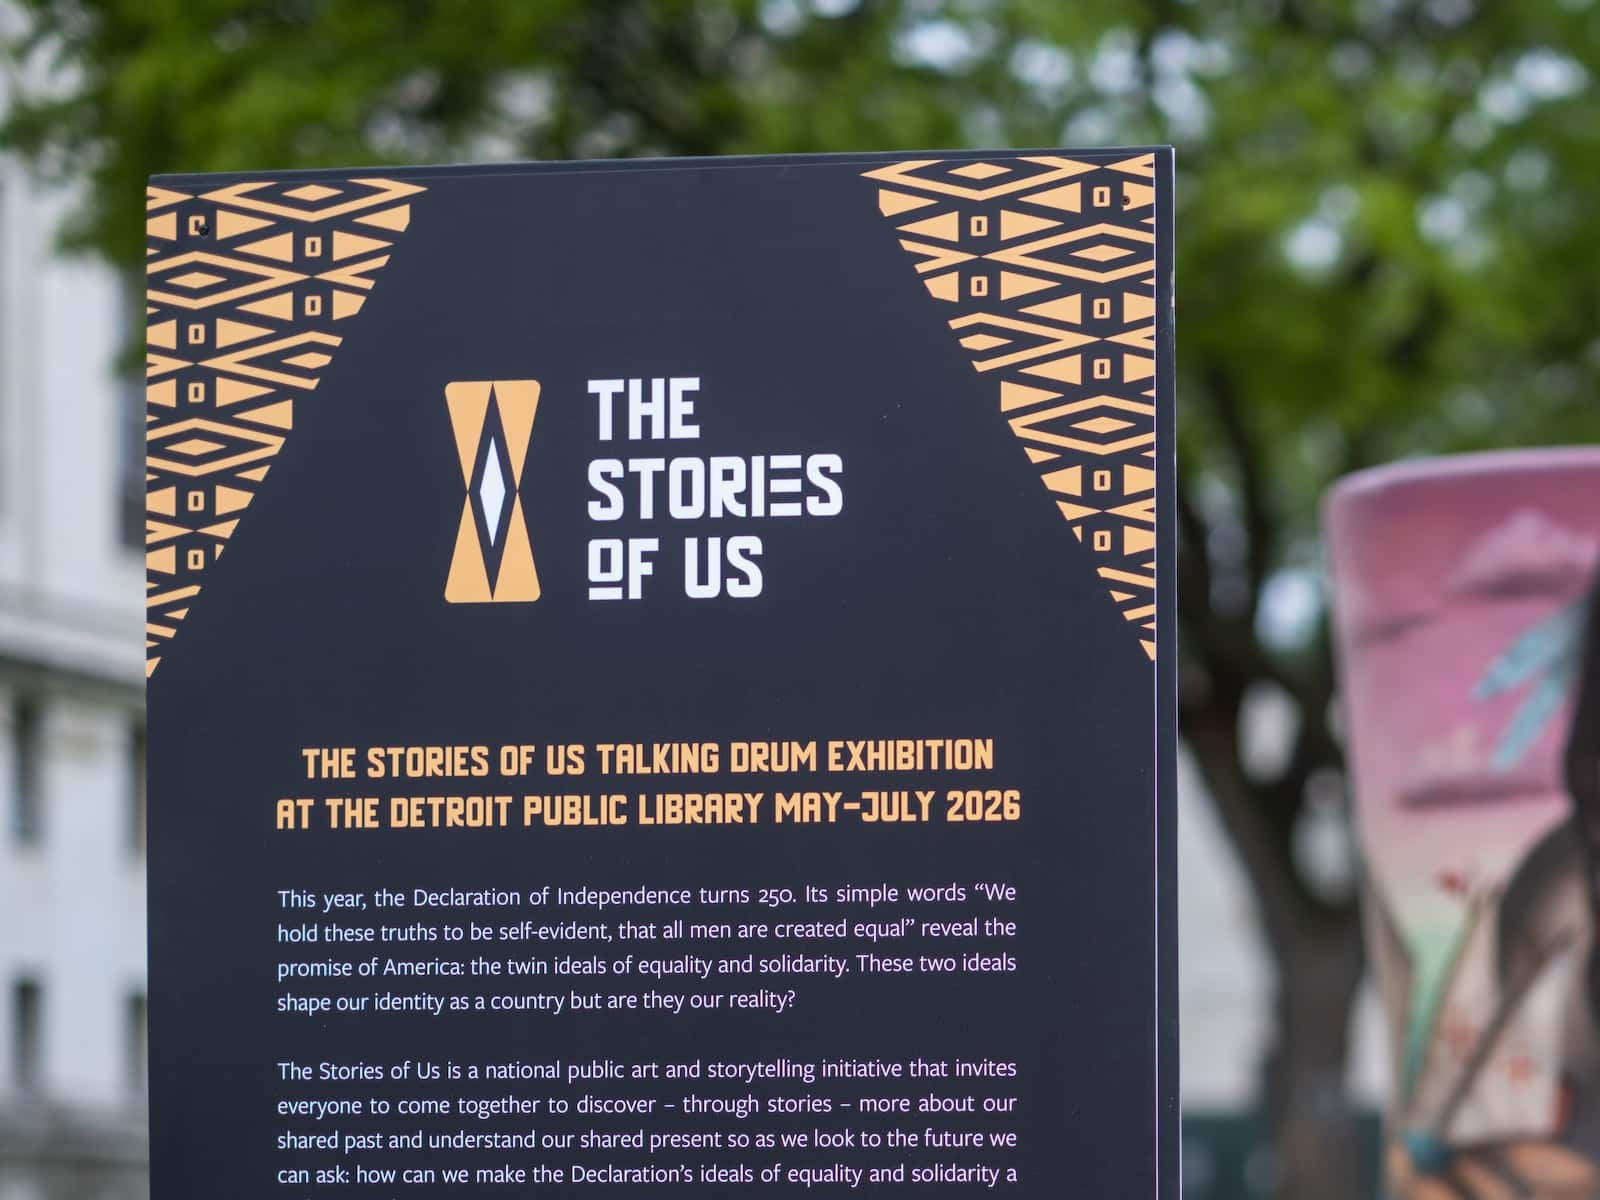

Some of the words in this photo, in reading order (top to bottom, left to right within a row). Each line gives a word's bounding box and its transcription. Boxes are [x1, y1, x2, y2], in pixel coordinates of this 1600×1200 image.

[587, 376, 701, 441] THE
[587, 453, 844, 522] STORIES
[587, 537, 660, 601] OF
[684, 535, 763, 599] US
[302, 747, 356, 779] THE
[367, 745, 489, 778] STORIES
[500, 744, 536, 777] OF
[546, 744, 585, 776] US
[596, 742, 720, 775] TALKING
[730, 741, 817, 773] DRUM
[828, 738, 994, 772] EXHIBITION
[276, 798, 315, 830] AT
[325, 797, 380, 829] THE
[390, 795, 513, 828] DETROIT
[523, 794, 628, 827] PUBLIC
[638, 792, 765, 825] LIBRARY
[946, 789, 1021, 822] 2026
[277, 888, 317, 908] This
[322, 893, 367, 913] year,
[373, 887, 405, 908] the
[413, 887, 521, 907] Declaration
[529, 885, 550, 906] of
[558, 885, 692, 911] Independence
[699, 887, 750, 904] turns
[758, 888, 797, 908] 250.
[806, 884, 829, 903] Its
[836, 882, 899, 908] simple
[906, 882, 967, 902] words
[974, 882, 1017, 901] “We
[278, 923, 318, 943] hold
[324, 922, 375, 943] these
[380, 921, 438, 942] truths
[443, 924, 464, 941] to
[470, 921, 494, 941] be
[499, 920, 613, 943] self-evident,
[617, 919, 657, 940] that
[662, 919, 683, 939] all
[690, 924, 732, 939] men
[737, 924, 769, 939] are
[774, 918, 847, 938] created
[853, 917, 915, 943] equal”
[921, 917, 978, 937] reveal
[983, 916, 1017, 937] the
[277, 958, 353, 983] promise
[358, 956, 379, 977] of
[382, 957, 465, 976] America:
[469, 956, 502, 976] the
[506, 956, 548, 976] twin
[554, 955, 607, 975] ideals
[612, 954, 633, 975] of
[638, 954, 713, 980] equality
[717, 954, 753, 974] and
[759, 953, 850, 979] solidarity.
[855, 952, 914, 973] These
[919, 955, 957, 972] two
[962, 951, 1017, 972] ideals
[277, 992, 332, 1017] shape
[336, 996, 370, 1011] our
[374, 991, 445, 1016] identity
[449, 995, 470, 1010] as
[474, 995, 486, 1010] a
[490, 993, 566, 1015] country
[570, 989, 603, 1009] but
[607, 994, 638, 1009] are
[642, 989, 685, 1015] they
[689, 994, 725, 1009] our
[729, 988, 796, 1014] reality?
[277, 1061, 313, 1081] The
[319, 1061, 384, 1081] Stories
[390, 1060, 411, 1080] of
[417, 1061, 441, 1080] Us
[447, 1060, 462, 1080] is
[467, 1065, 480, 1080] a
[485, 1059, 561, 1080] national
[568, 1059, 625, 1085] public
[631, 1062, 659, 1079] art
[665, 1059, 701, 1079] and
[707, 1058, 816, 1084] storytelling
[822, 1058, 903, 1078] initiative
[908, 1057, 949, 1078] that
[955, 1058, 1017, 1077] invites
